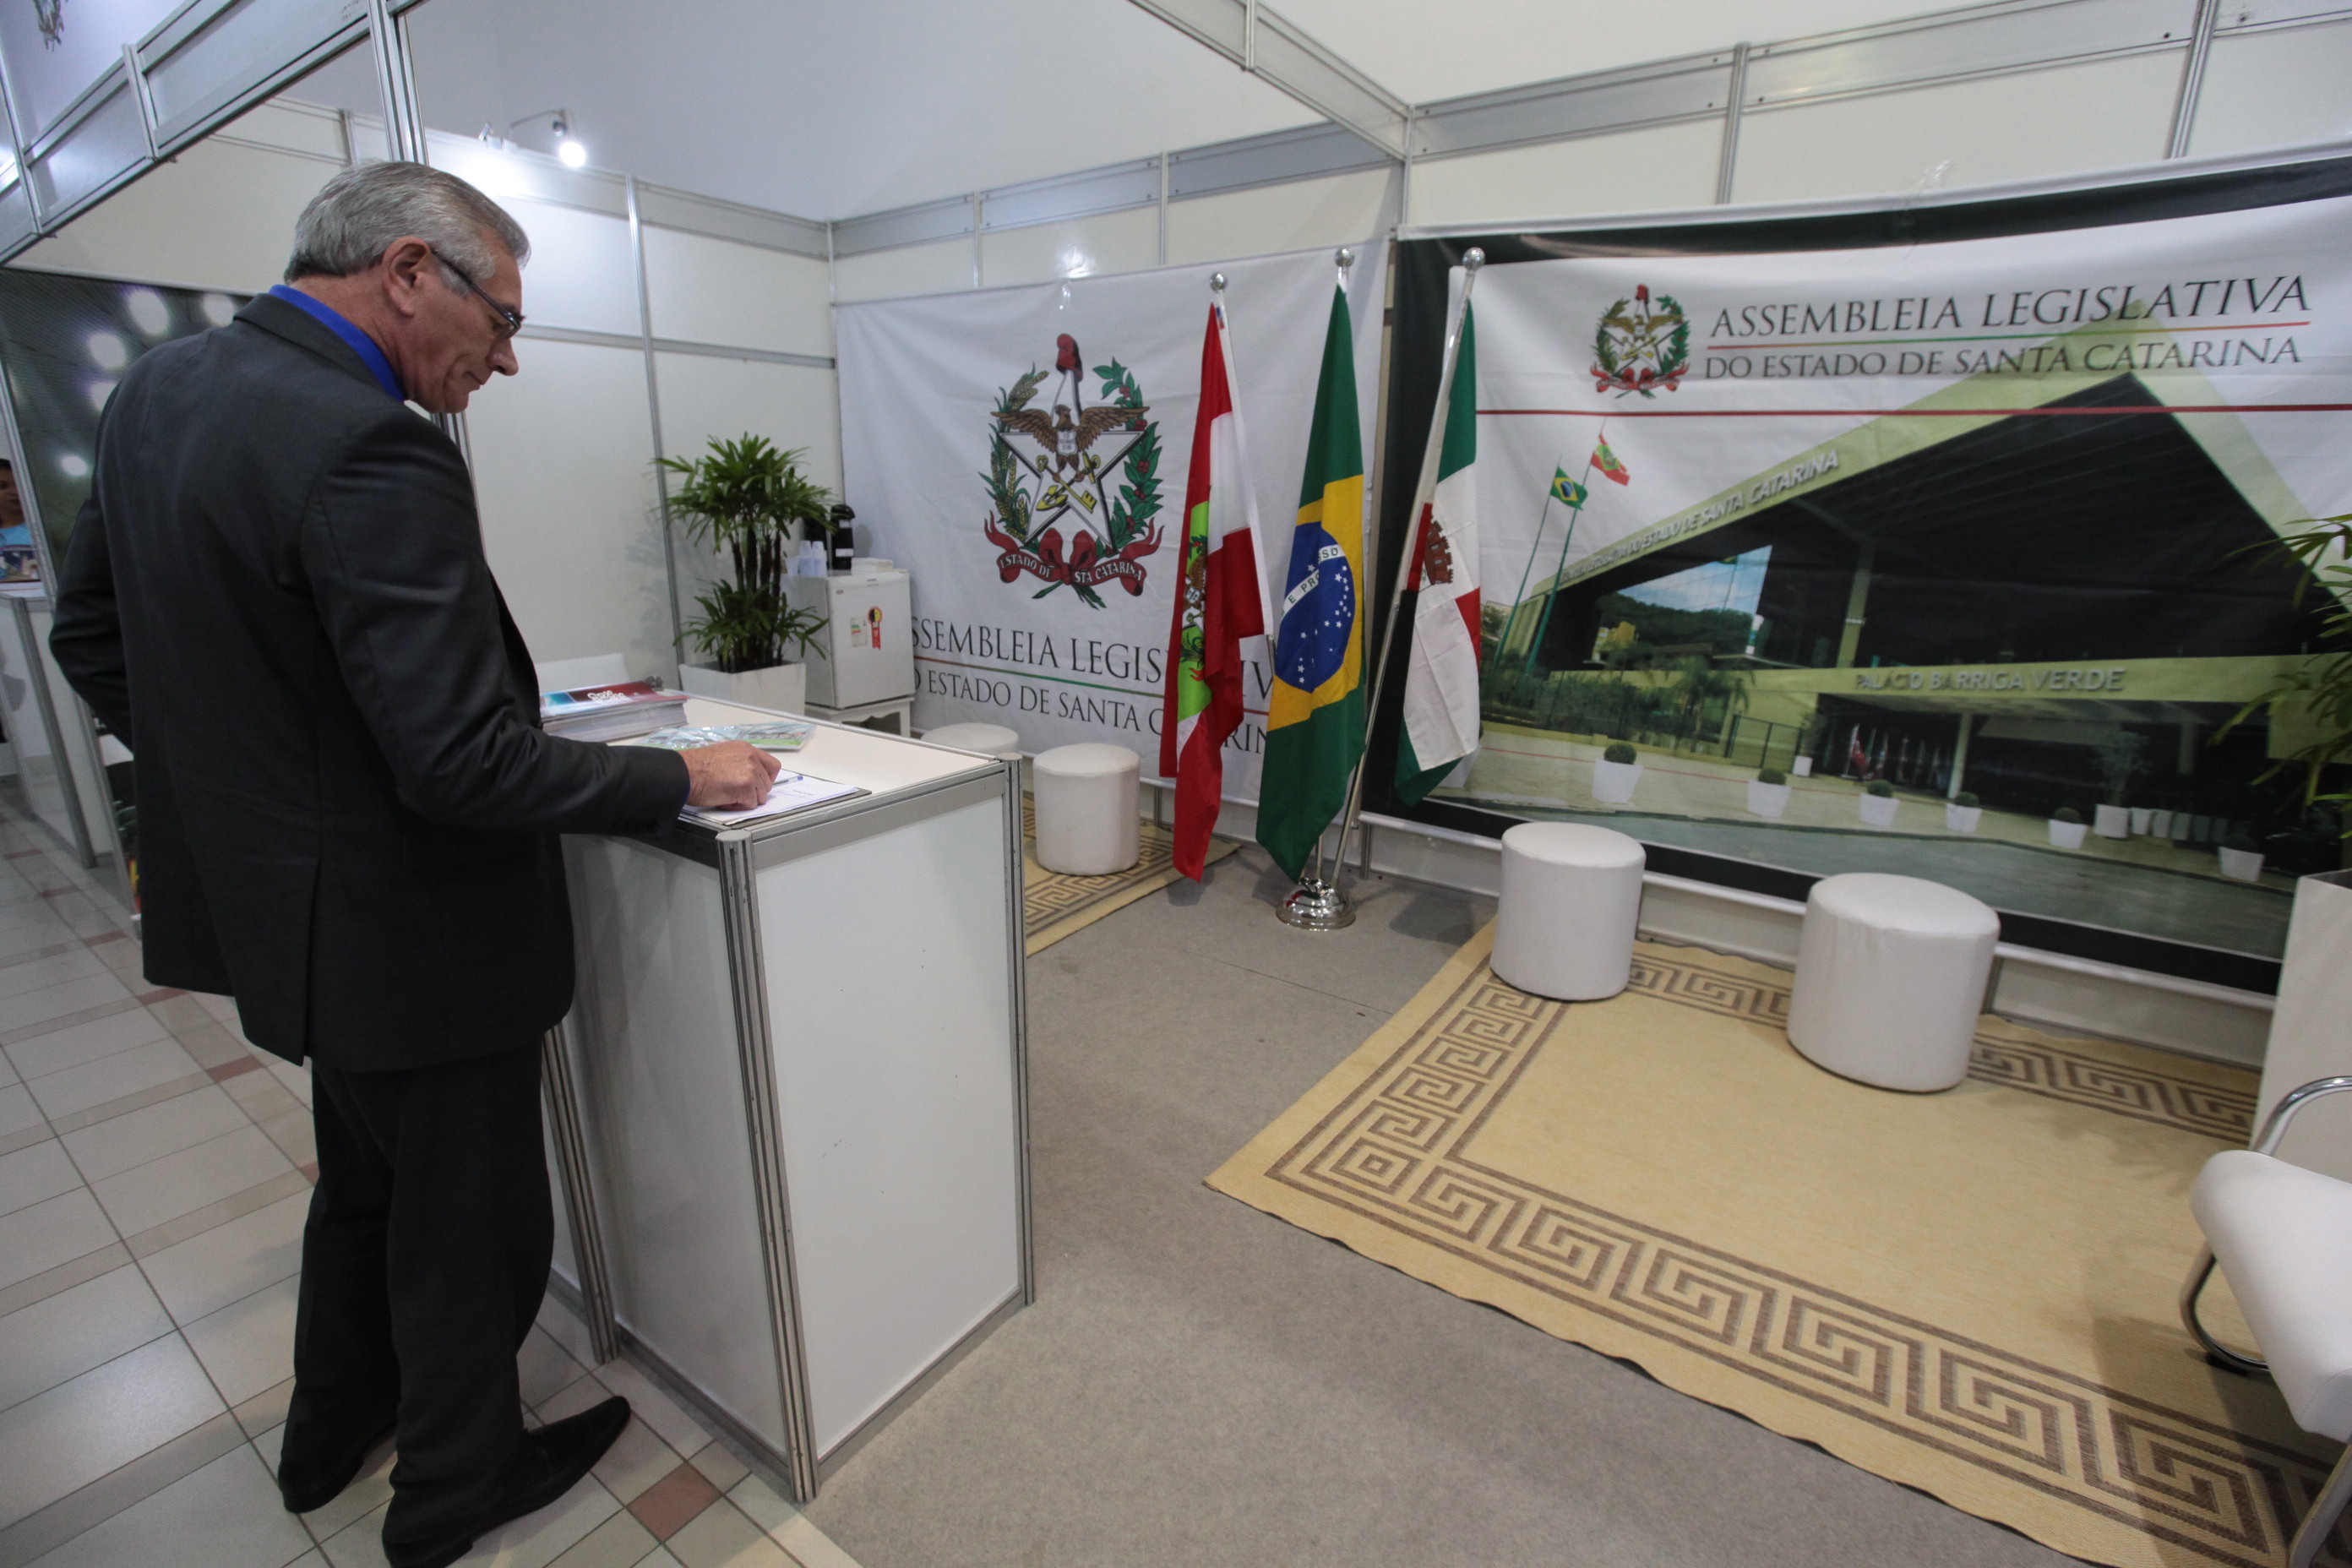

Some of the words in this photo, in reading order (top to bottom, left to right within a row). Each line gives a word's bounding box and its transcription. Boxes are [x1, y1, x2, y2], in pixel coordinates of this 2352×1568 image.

[1710, 296, 1963, 338] ASSEMBLEIA
[1982, 275, 2312, 326] LEGISLATIVA
[1705, 355, 1753, 379] DO
[1762, 351, 1887, 378] ESTADO
[1897, 350, 1944, 375] DE
[1952, 345, 2072, 374] SANTA
[2084, 336, 2304, 372] CATARINA
[1701, 493, 1745, 526] SANTA
[1748, 449, 1838, 505] CATARINA
[999, 553, 1037, 570] ESTADO
[1039, 565, 1052, 578] DE
[1074, 570, 1093, 583] STA
[1095, 561, 1142, 581] CATARINA
[912, 616, 1060, 668] SSEMBLEIA
[928, 669, 1011, 706] ESTADO
[1020, 685, 1050, 715] DE
[1058, 691, 1142, 732] SANTA
[1930, 671, 2026, 691] BARRIGA
[2031, 667, 2126, 692] VERDE
